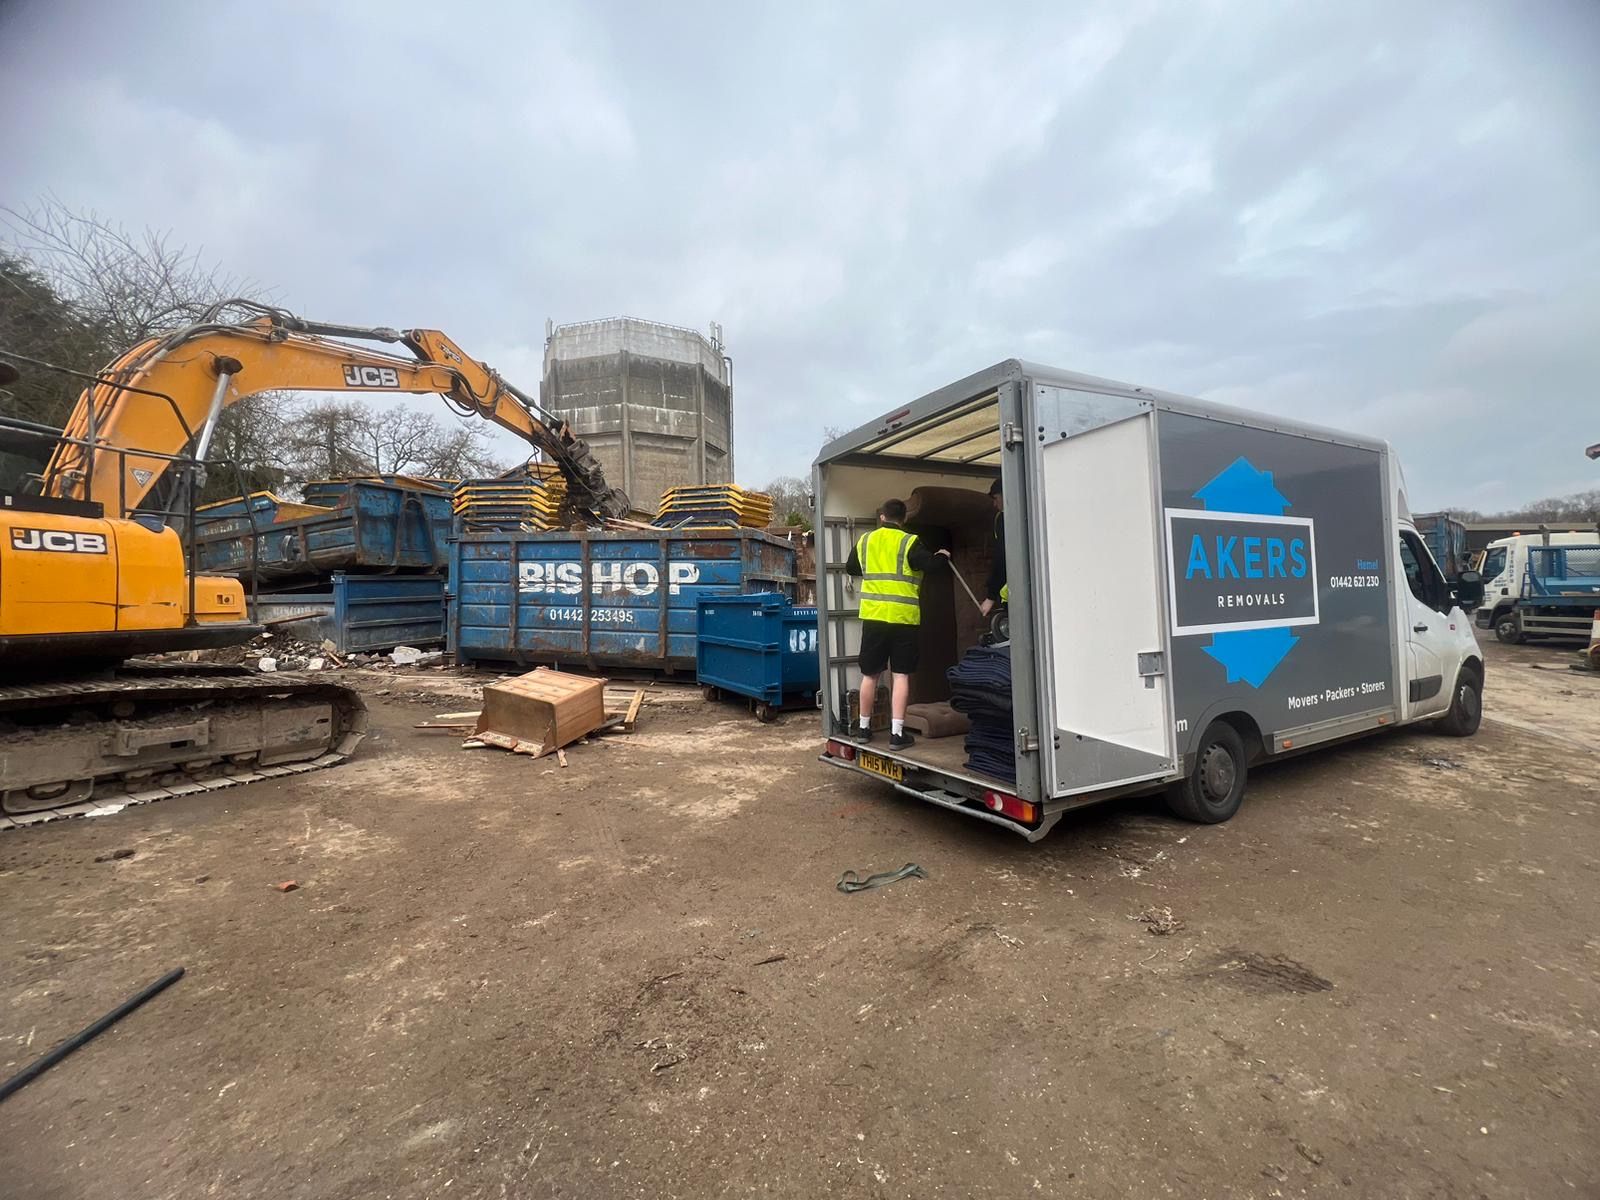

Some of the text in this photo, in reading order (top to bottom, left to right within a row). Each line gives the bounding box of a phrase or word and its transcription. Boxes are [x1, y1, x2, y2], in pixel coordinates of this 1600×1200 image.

[345, 365, 399, 387] JCB
[13, 529, 106, 553] JCB
[1185, 534, 1308, 579] AKERS
[518, 562, 700, 596] BISHOP
[1330, 575, 1380, 588] 01442 621 230
[1217, 593, 1285, 608] REMOVALS
[549, 609, 634, 622] 01442 253495
[1288, 681, 1386, 710] Movers Packers Storers
